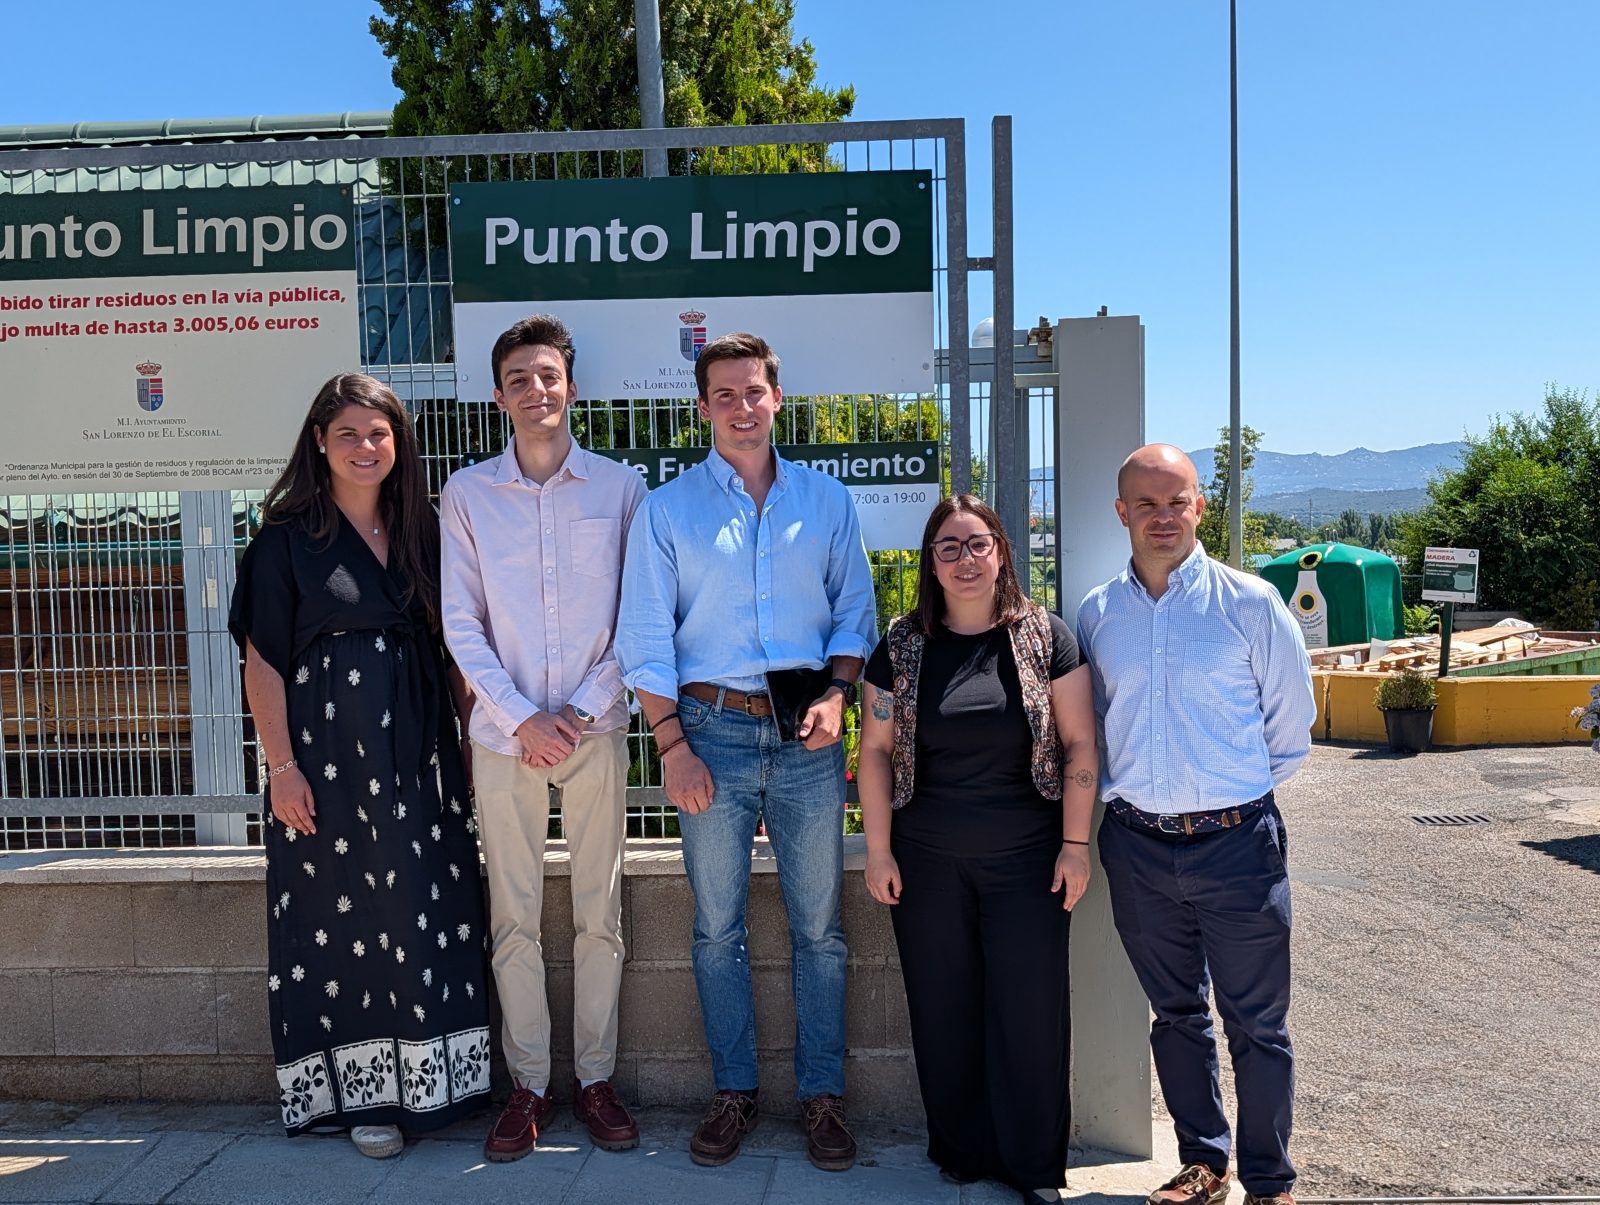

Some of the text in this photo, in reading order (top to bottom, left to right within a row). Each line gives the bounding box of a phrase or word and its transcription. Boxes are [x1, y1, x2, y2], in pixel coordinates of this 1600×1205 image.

[142, 204, 347, 267] Limpio
[484, 208, 901, 272] Punto Limpio
[48, 294, 90, 309] tirar
[95, 292, 177, 307] residuos
[182, 293, 207, 305] en
[212, 290, 229, 304] la
[234, 289, 263, 303] vía
[269, 287, 346, 307] pública,
[25, 322, 80, 336] multa
[85, 320, 109, 335] de
[114, 320, 167, 334] hasta
[173, 316, 259, 333] 3.005,06
[264, 317, 319, 330] euros
[623, 380, 641, 390] SAN
[645, 380, 687, 389] LORENZO
[83, 430, 100, 440] SAN
[104, 429, 145, 439] LORENZO
[178, 427, 222, 437] ESCORIAL
[51, 461, 86, 471] Municipal
[88, 462, 105, 471] para
[107, 461, 113, 469] la
[115, 460, 142, 470] gestión
[155, 459, 187, 467] residuos
[189, 460, 195, 468] y
[195, 458, 234, 468] regulación
[247, 457, 255, 465] la
[256, 456, 288, 467] limpieza
[6, 473, 26, 482] pleno
[73, 472, 97, 480] sesión
[99, 471, 111, 479] del
[112, 471, 122, 479] 30
[124, 470, 134, 478] de
[135, 470, 178, 479] Septiembre
[180, 469, 189, 477] de
[191, 468, 210, 477] 2008
[212, 467, 243, 476] BOCAM
[264, 467, 274, 475] de
[849, 491, 926, 505] 7:00 a 19:00
